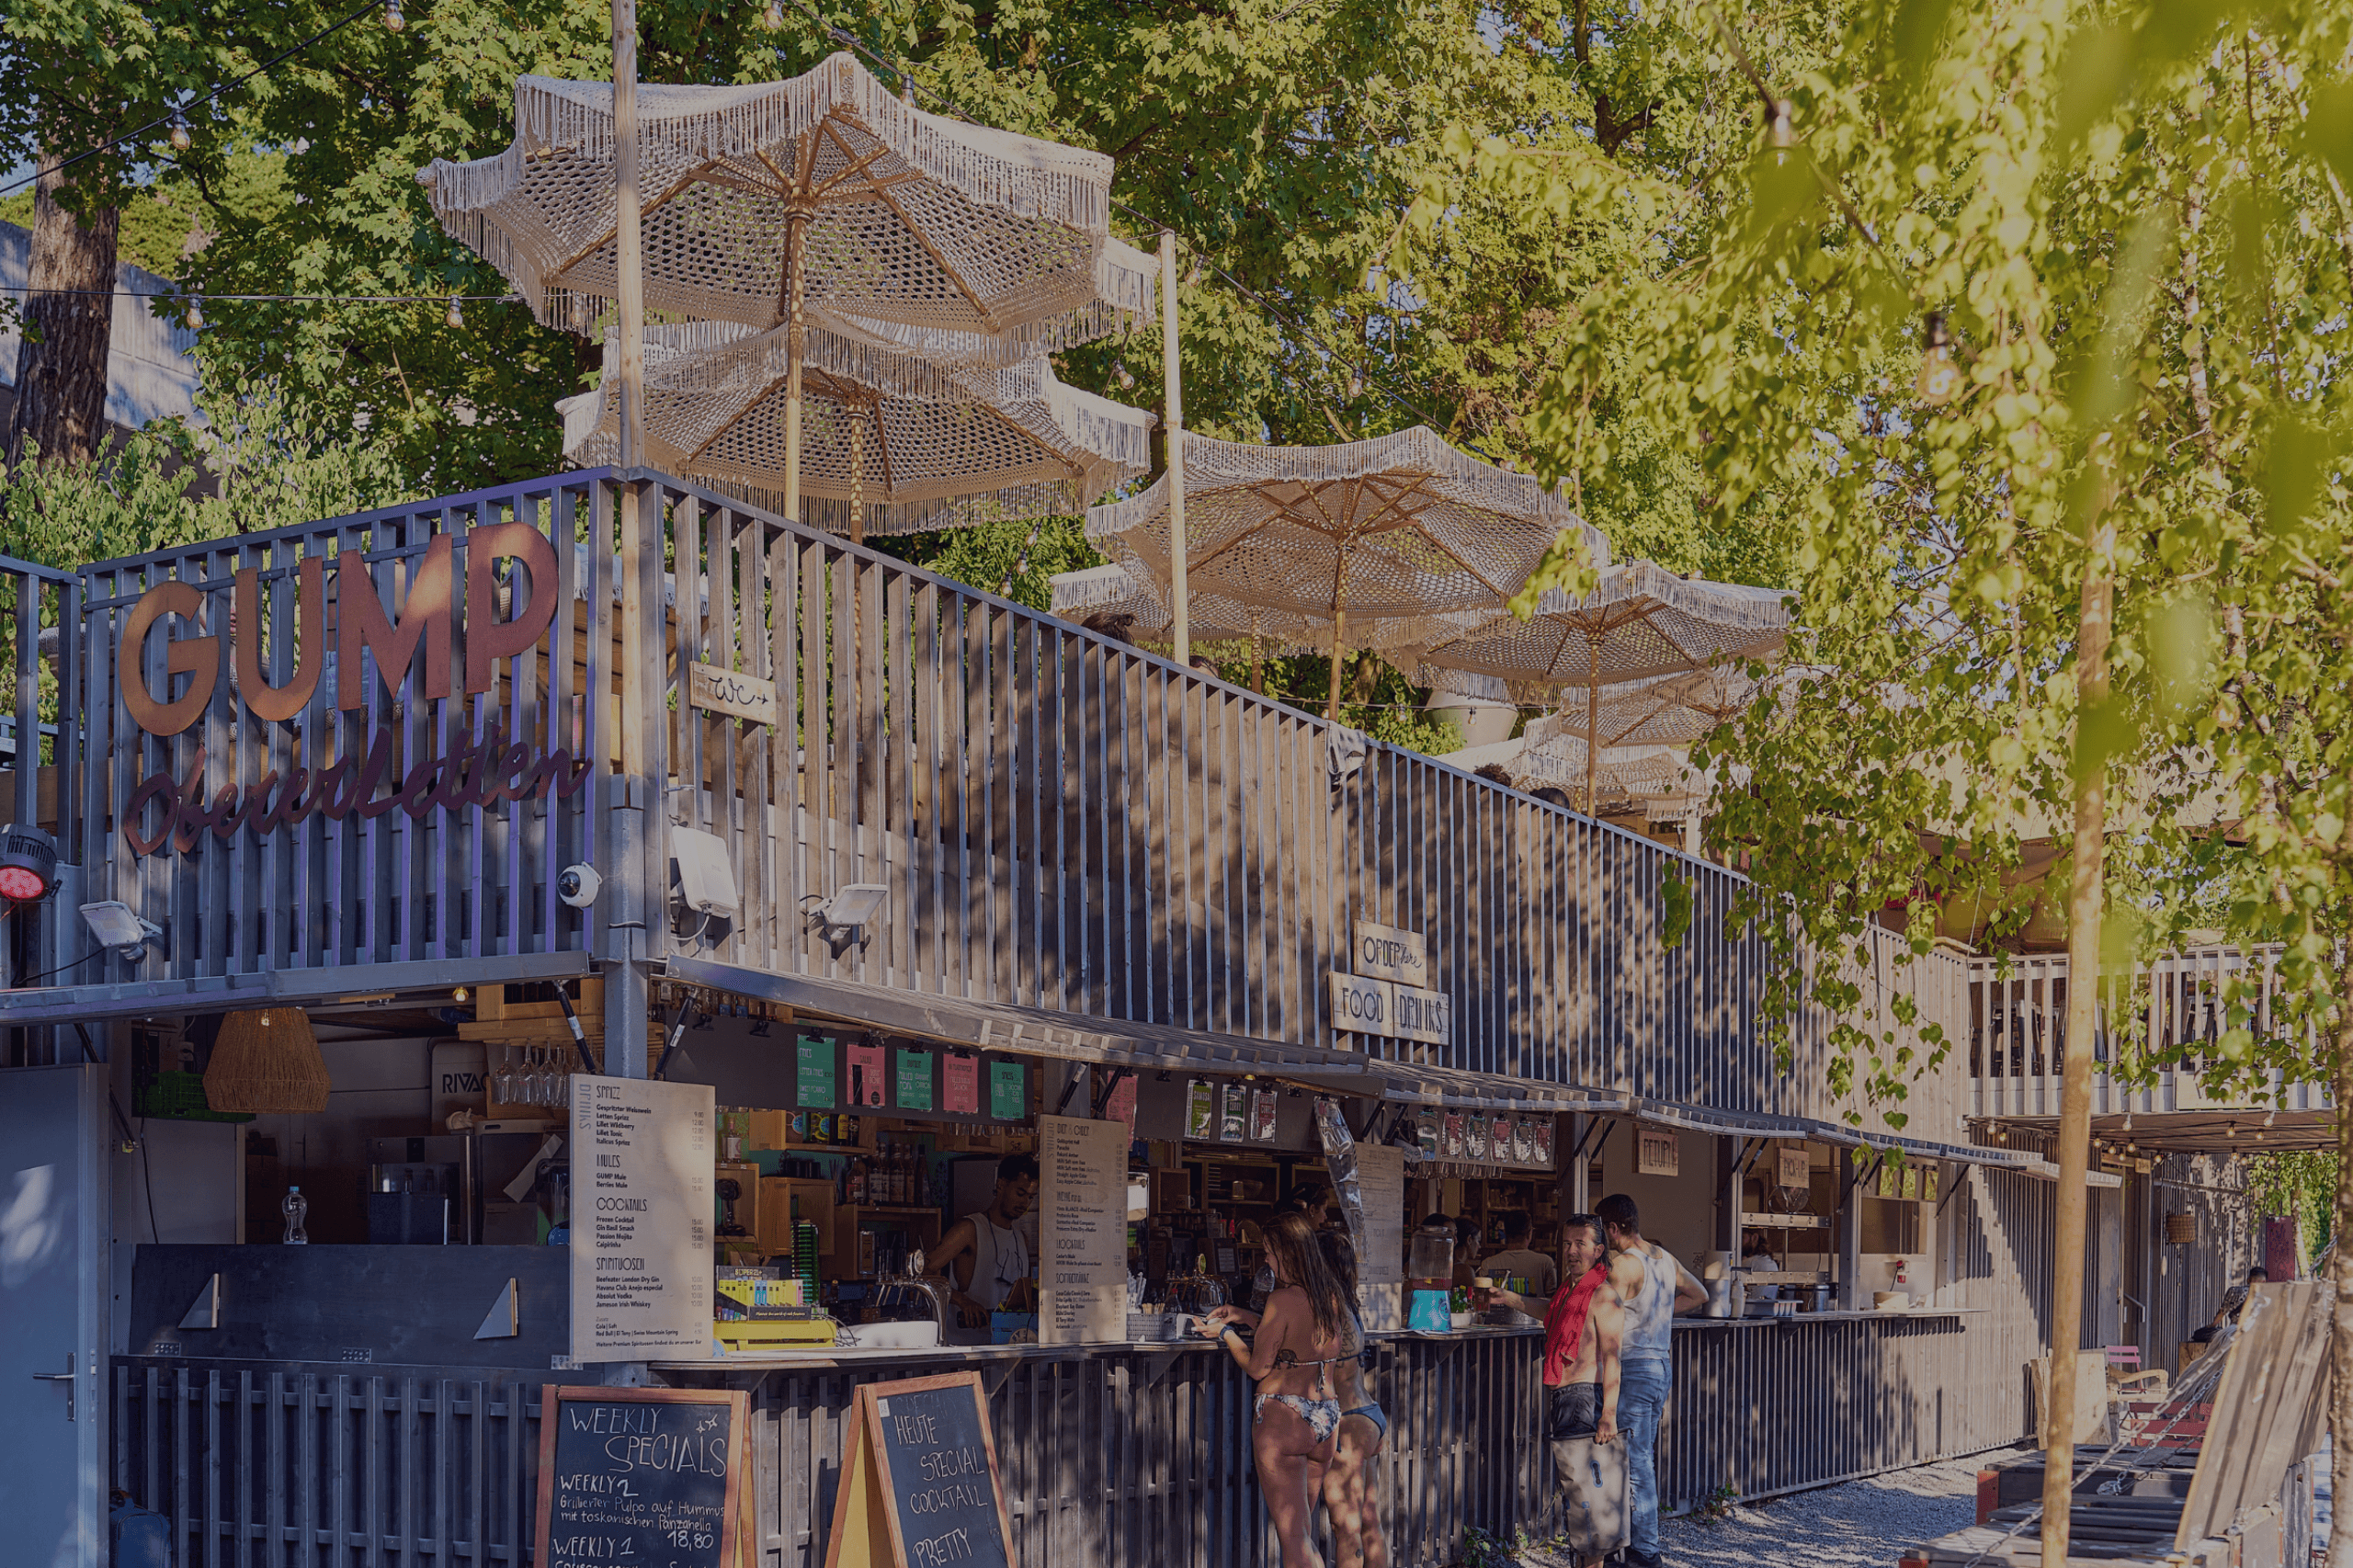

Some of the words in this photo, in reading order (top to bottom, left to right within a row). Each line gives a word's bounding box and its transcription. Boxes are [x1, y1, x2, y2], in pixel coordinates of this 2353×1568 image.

[119, 521, 559, 735] GUMP
[1363, 937, 1400, 969] ORDER
[1399, 946, 1422, 969] here
[1342, 987, 1383, 1023] FOOD
[1399, 994, 1442, 1035] DRINKS
[596, 1104, 625, 1113] Gespritzter
[614, 1114, 630, 1122] Sprizz
[609, 1122, 635, 1131] Wildberry
[615, 1139, 631, 1147] Sprizz
[597, 1153, 620, 1168] MULES
[596, 1197, 647, 1211] COCKTAILS
[570, 1407, 663, 1434] WEEKLY
[894, 1414, 939, 1446] HEUTE
[605, 1434, 726, 1477] SPECIALS
[920, 1446, 985, 1482] SPECIAL
[560, 1474, 618, 1494] WEEKLY
[617, 1479, 639, 1496] 2
[560, 1494, 610, 1510] Grillierter
[615, 1498, 645, 1517] Pulpo
[651, 1500, 674, 1517] auf
[678, 1501, 724, 1517] Hummus
[910, 1484, 988, 1514] COCKTAIL
[561, 1511, 577, 1521] mit
[581, 1511, 654, 1528] toskanischen
[553, 1537, 617, 1559] WEEKLY
[620, 1537, 635, 1555] 1
[667, 1530, 714, 1551] 18,80
[912, 1527, 972, 1568] PRETTY
